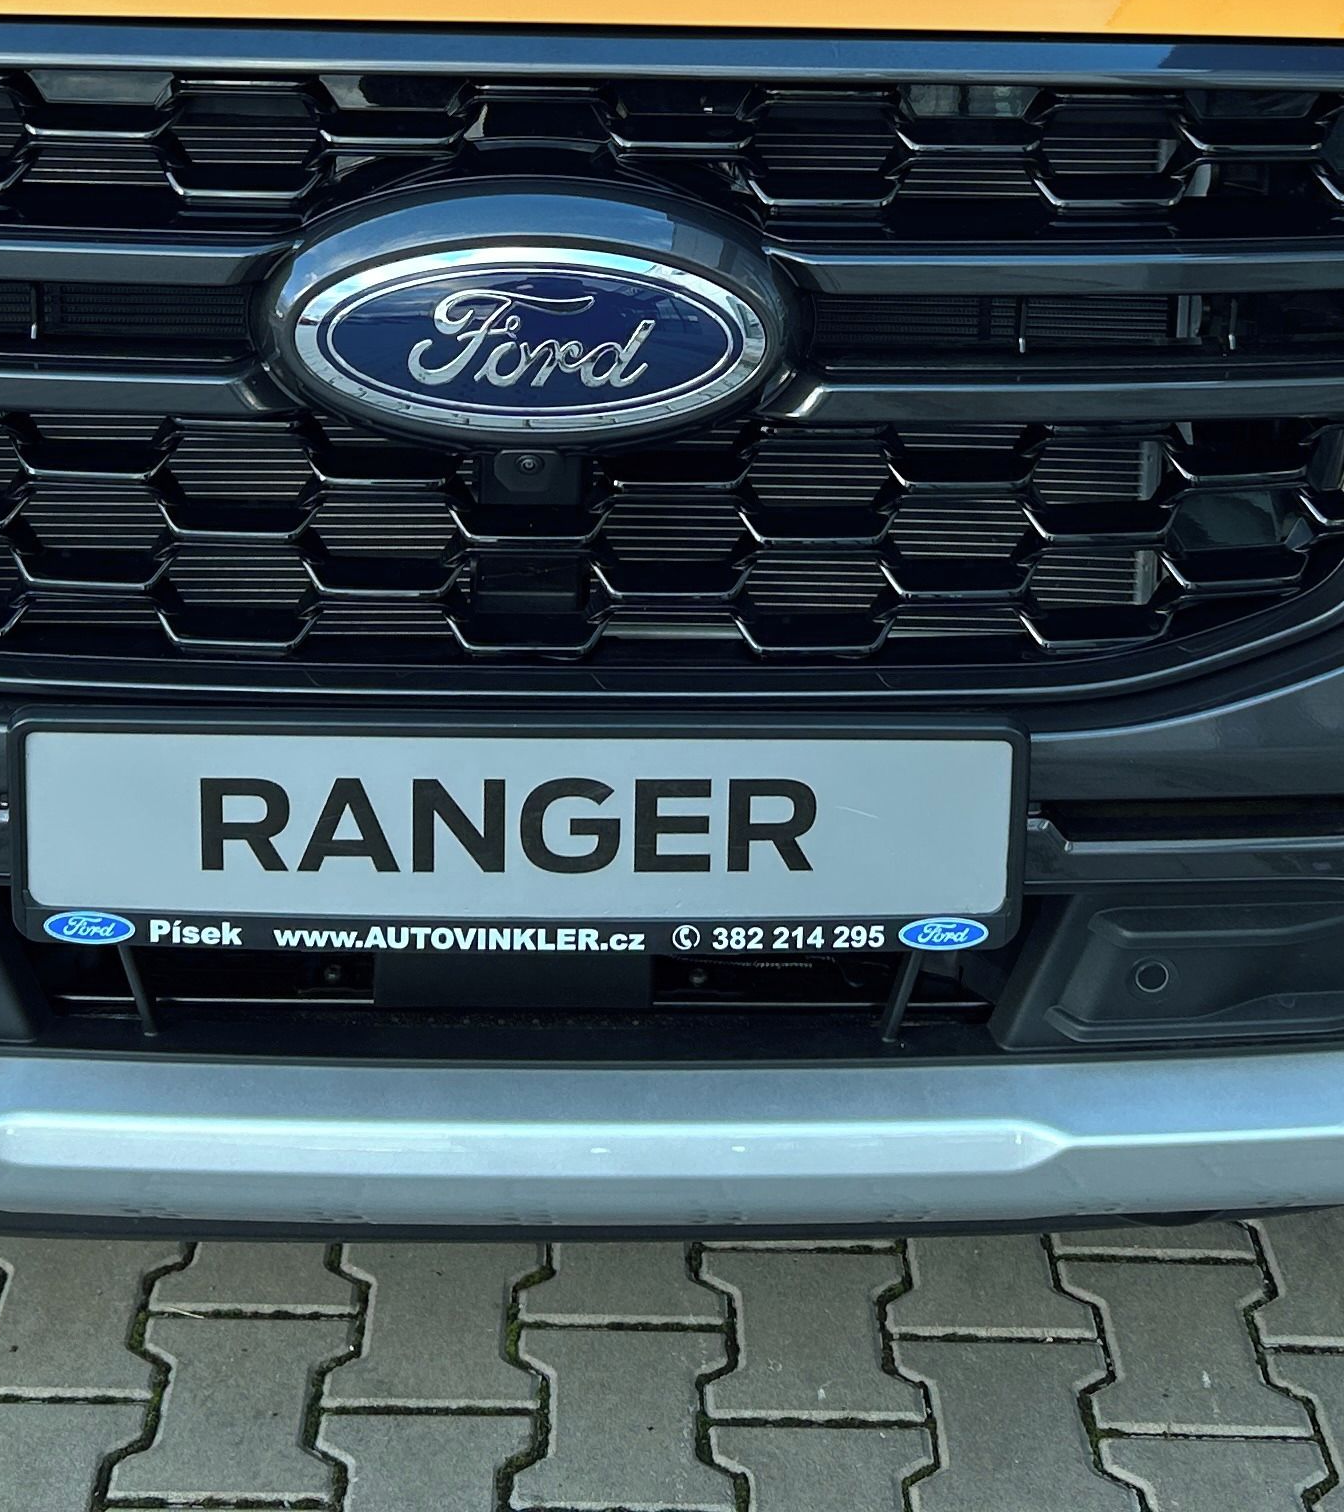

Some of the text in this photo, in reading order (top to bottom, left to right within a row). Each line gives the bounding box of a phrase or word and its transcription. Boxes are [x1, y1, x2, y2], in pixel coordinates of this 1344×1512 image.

[408, 289, 655, 388] Ford
[199, 777, 817, 874] RANGER
[62, 915, 970, 951] Ford Písek www.AUTOVINKLER.cz 382 214 295 Ford
